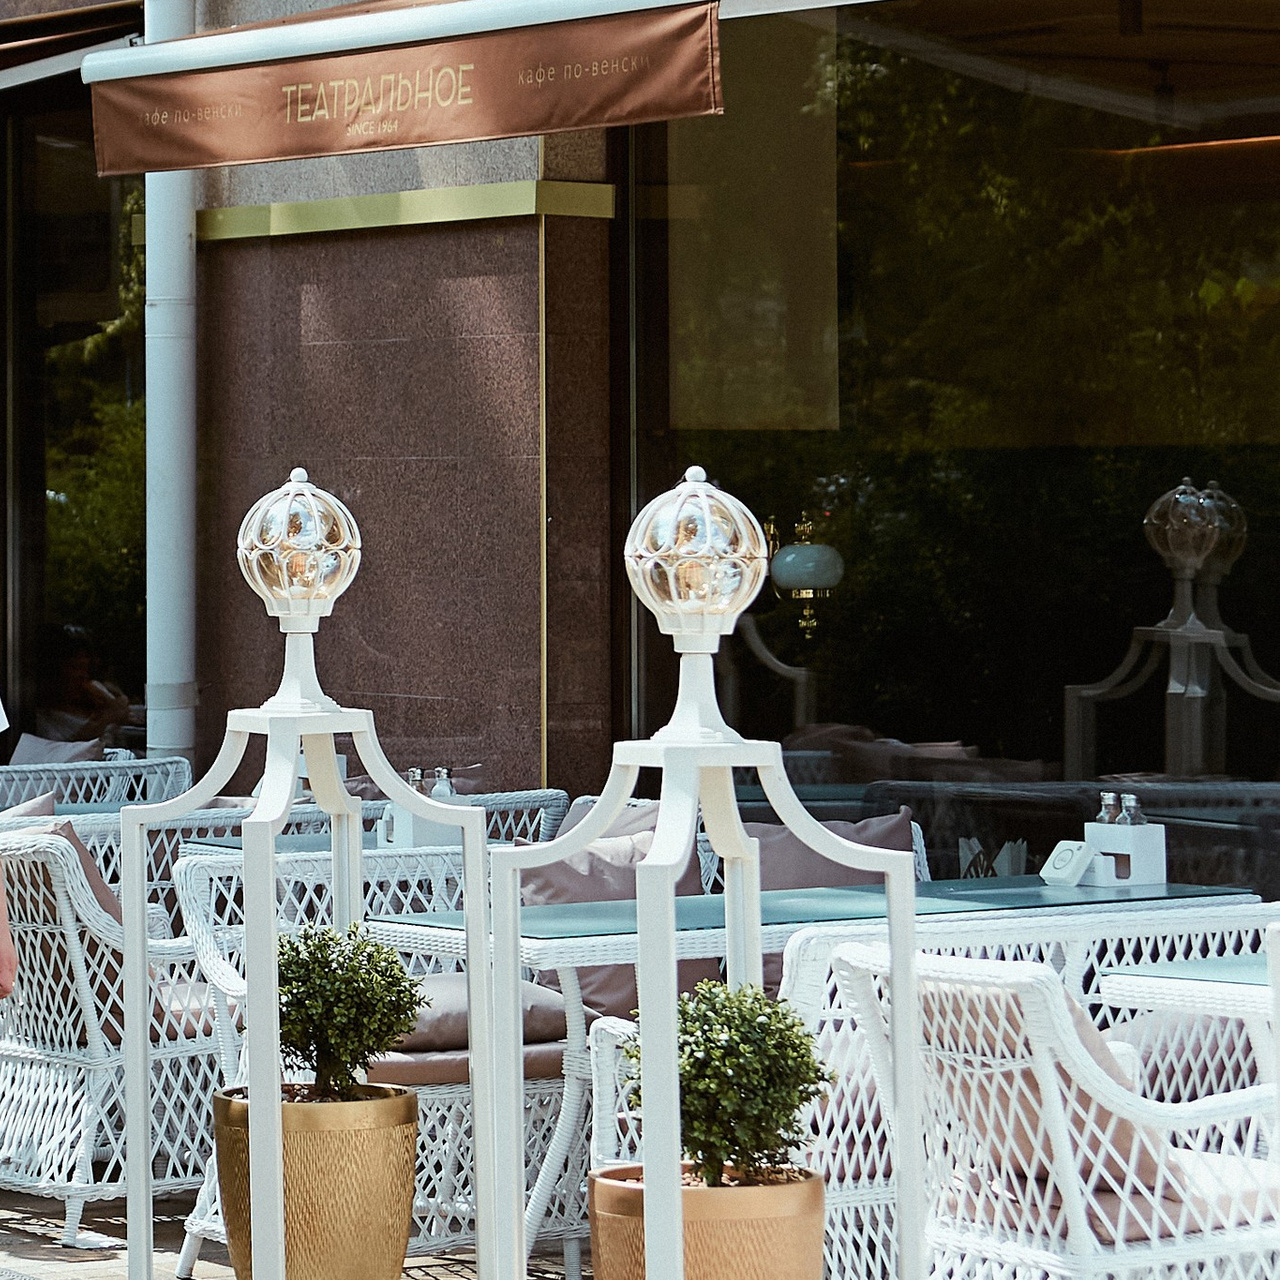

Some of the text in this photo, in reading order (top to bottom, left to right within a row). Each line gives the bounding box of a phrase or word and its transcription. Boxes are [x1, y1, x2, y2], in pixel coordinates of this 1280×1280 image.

[517, 61, 556, 89] кафе
[281, 63, 475, 124] ТЕАТРАЛЬНОЕ
[140, 101, 243, 127] афе по-венски
[346, 118, 399, 136] SINCE 1964
